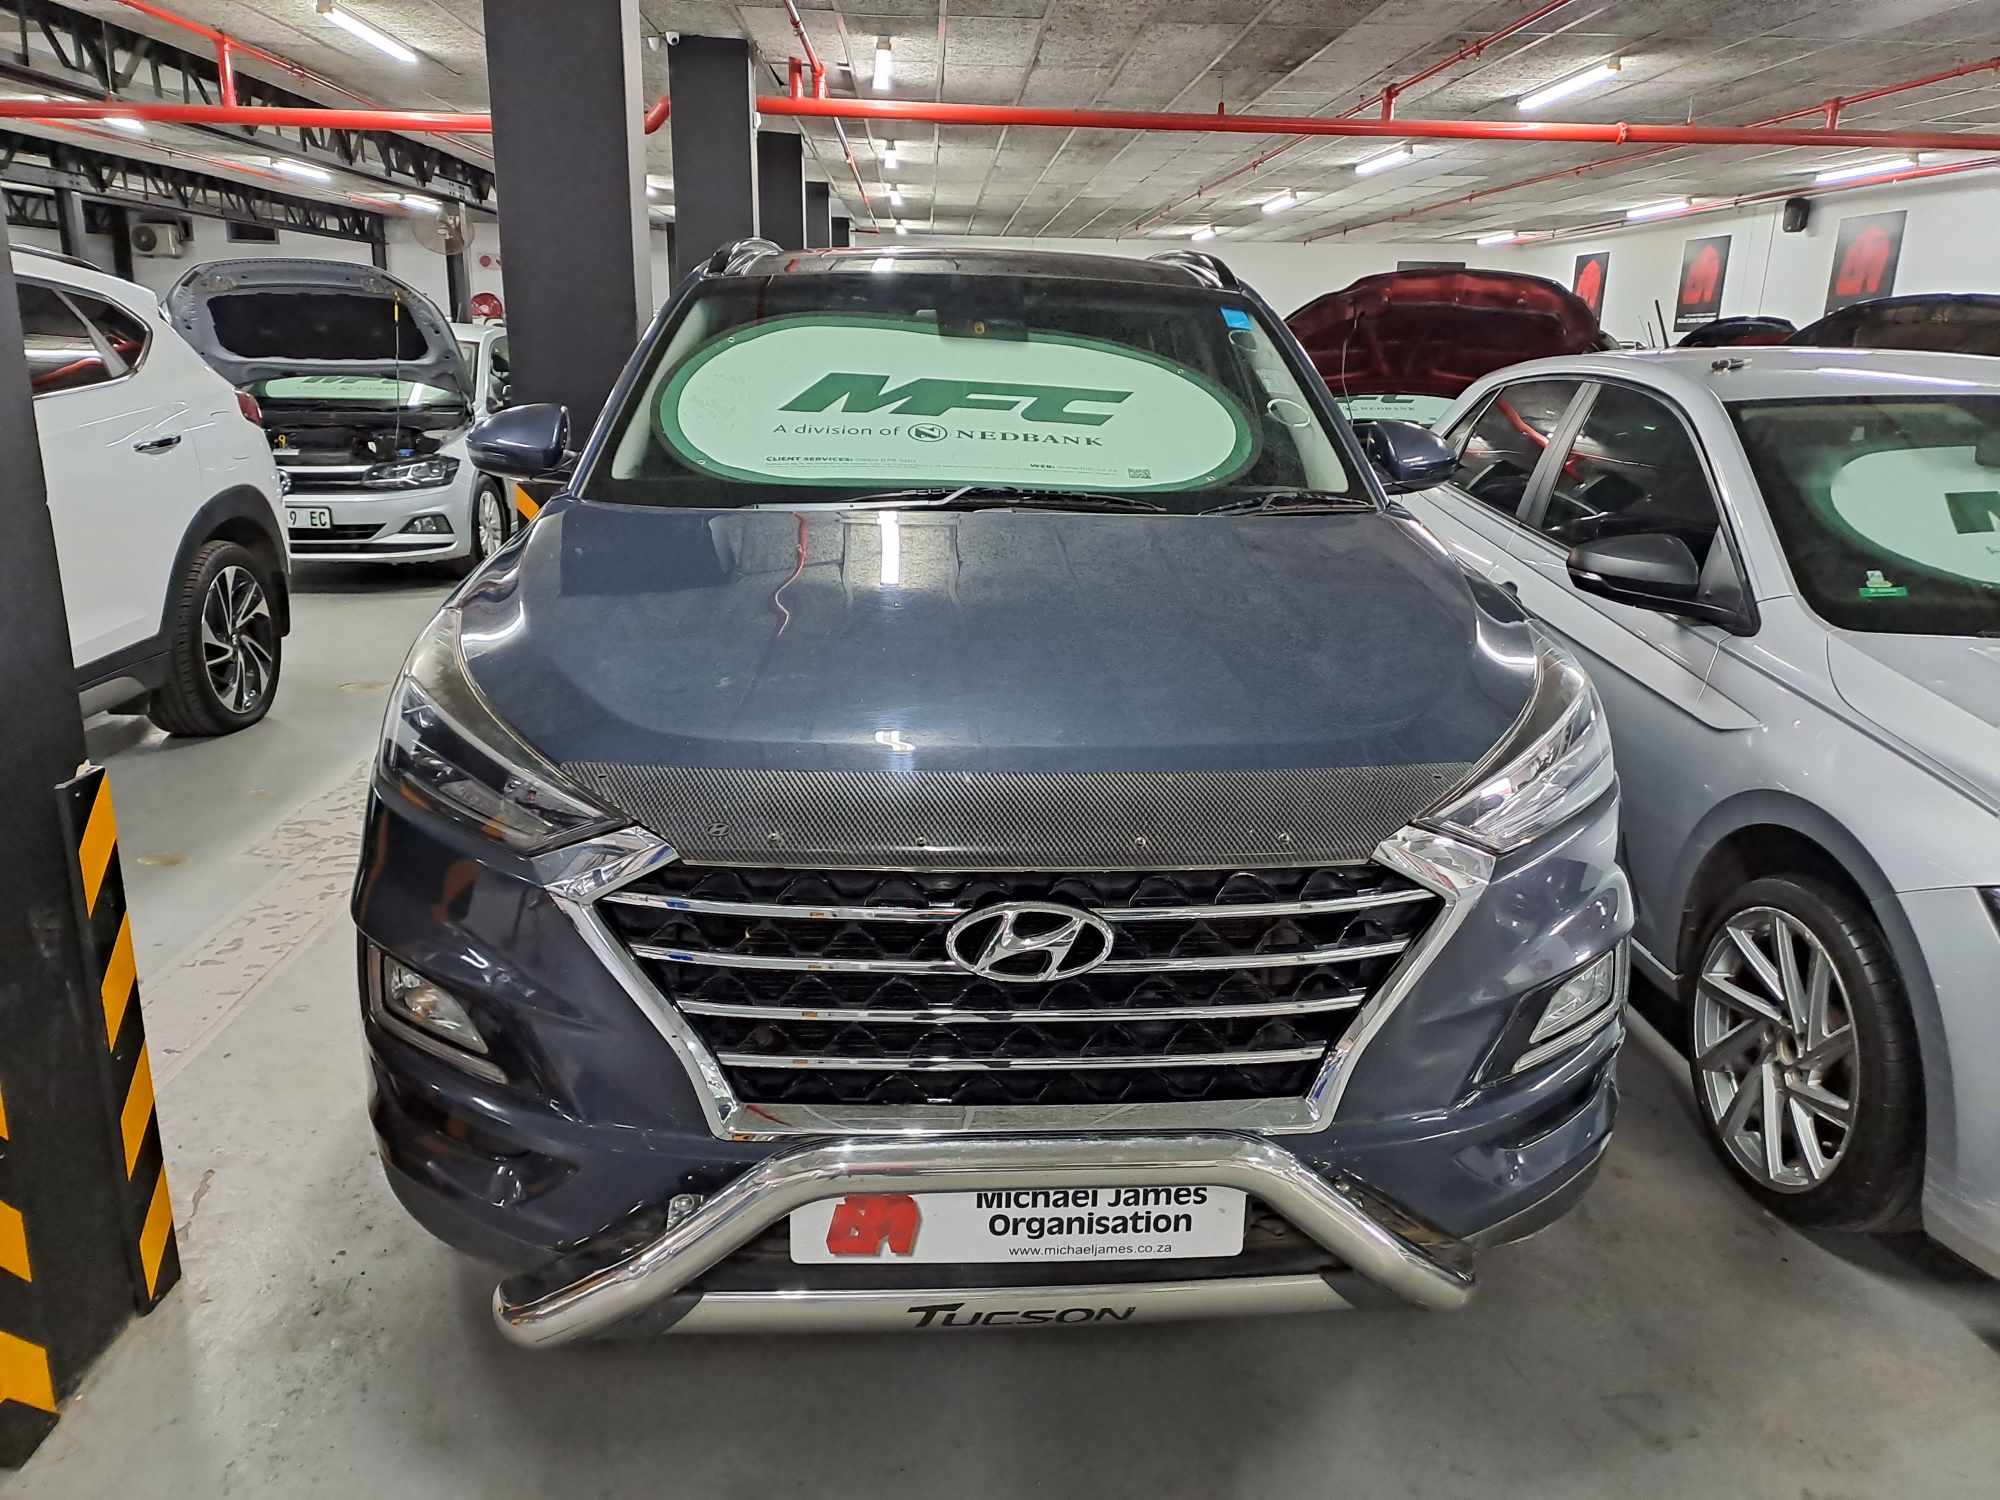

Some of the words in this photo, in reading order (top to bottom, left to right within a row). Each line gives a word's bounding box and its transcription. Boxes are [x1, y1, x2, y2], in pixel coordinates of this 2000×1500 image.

[777, 372, 1134, 426] MFC
[773, 424, 787, 434] A
[794, 423, 872, 436] division
[879, 425, 901, 436] of
[957, 429, 1103, 446] NEDBANK
[310, 511, 327, 527] EC
[1107, 1186, 1208, 1208] James
[989, 1210, 1192, 1240] Organisation
[1009, 1243, 1172, 1257] www.michaeljames.co.za
